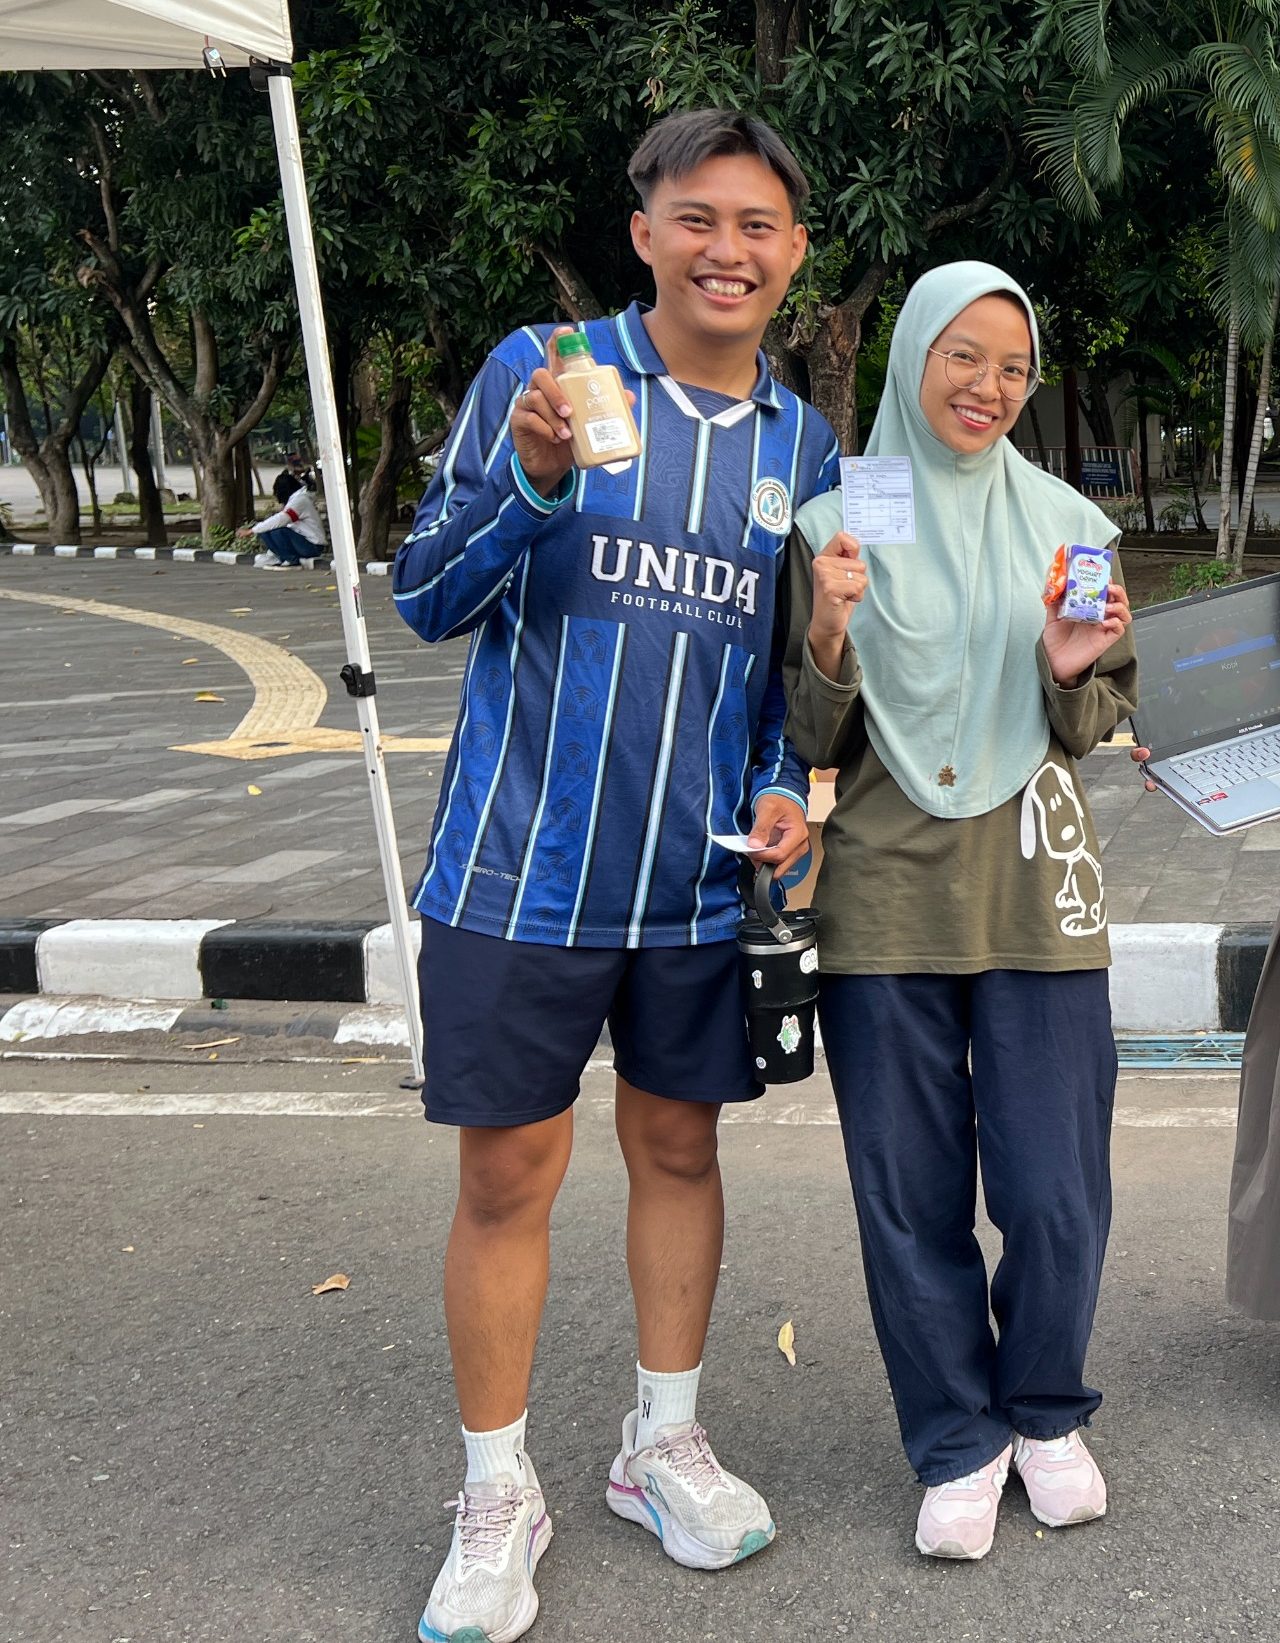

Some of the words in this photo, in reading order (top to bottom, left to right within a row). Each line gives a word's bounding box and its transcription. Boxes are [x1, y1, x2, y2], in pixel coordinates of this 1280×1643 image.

[590, 534, 760, 616] UNIDA
[610, 591, 702, 619] FOOTBALL
[642, 1399, 651, 1420] N
